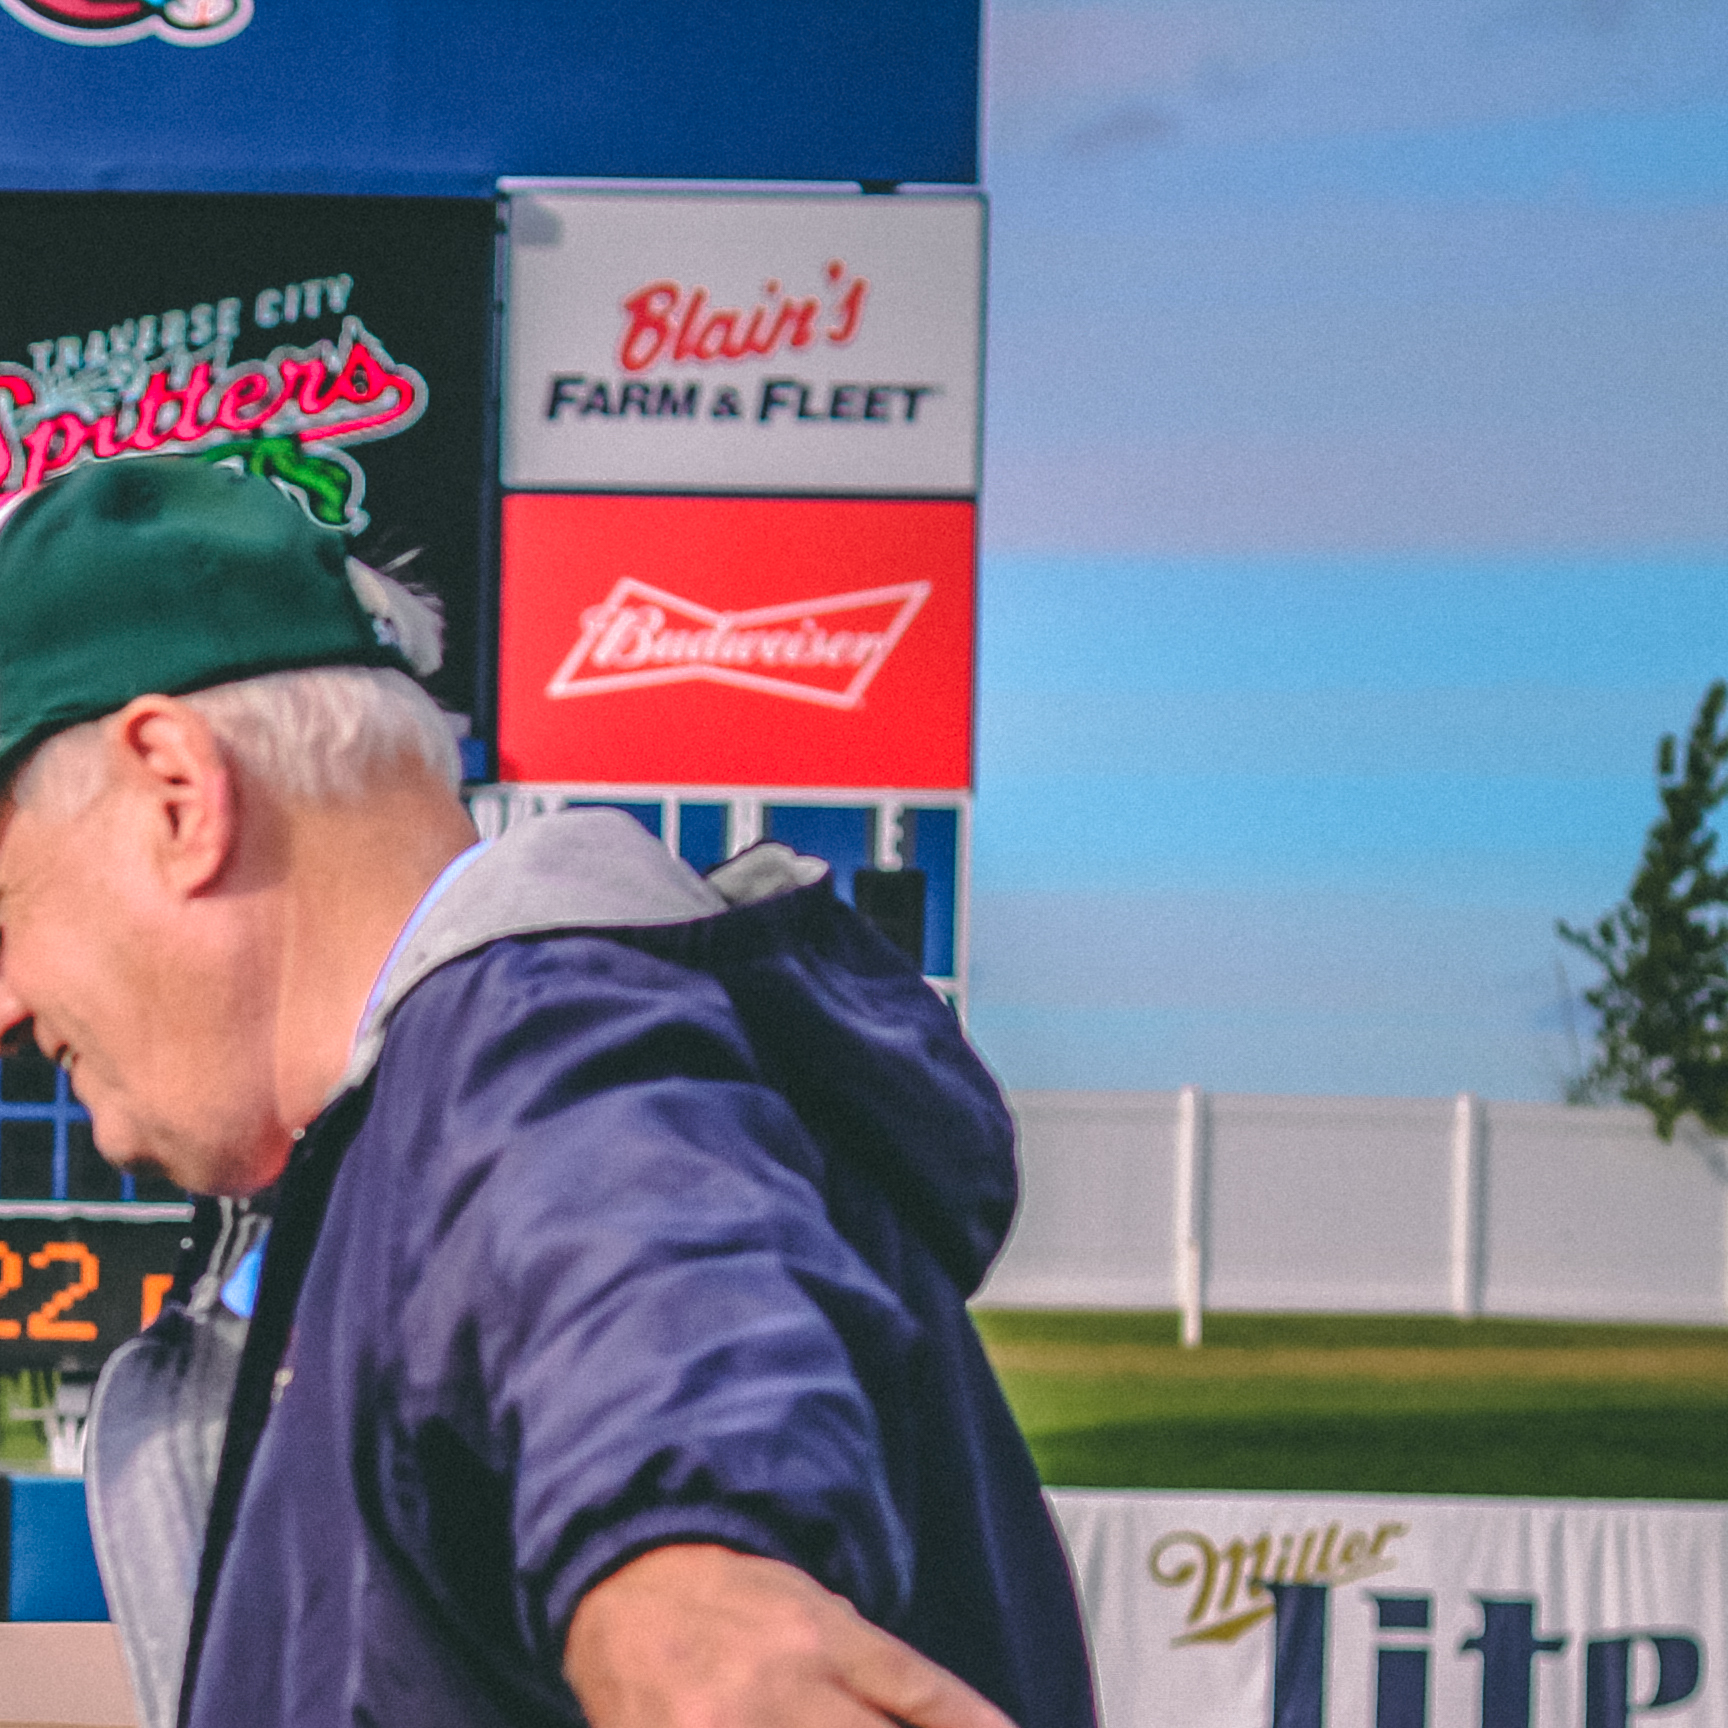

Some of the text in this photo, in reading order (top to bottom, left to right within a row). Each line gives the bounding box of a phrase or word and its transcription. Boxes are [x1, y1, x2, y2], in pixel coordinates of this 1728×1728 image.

[255, 273, 354, 329] CITY
[621, 259, 870, 371] Blain's
[547, 375, 929, 423] FARM & FLEET
[579, 606, 889, 668] Budweiser
[1150, 1522, 1406, 1626] Miller
